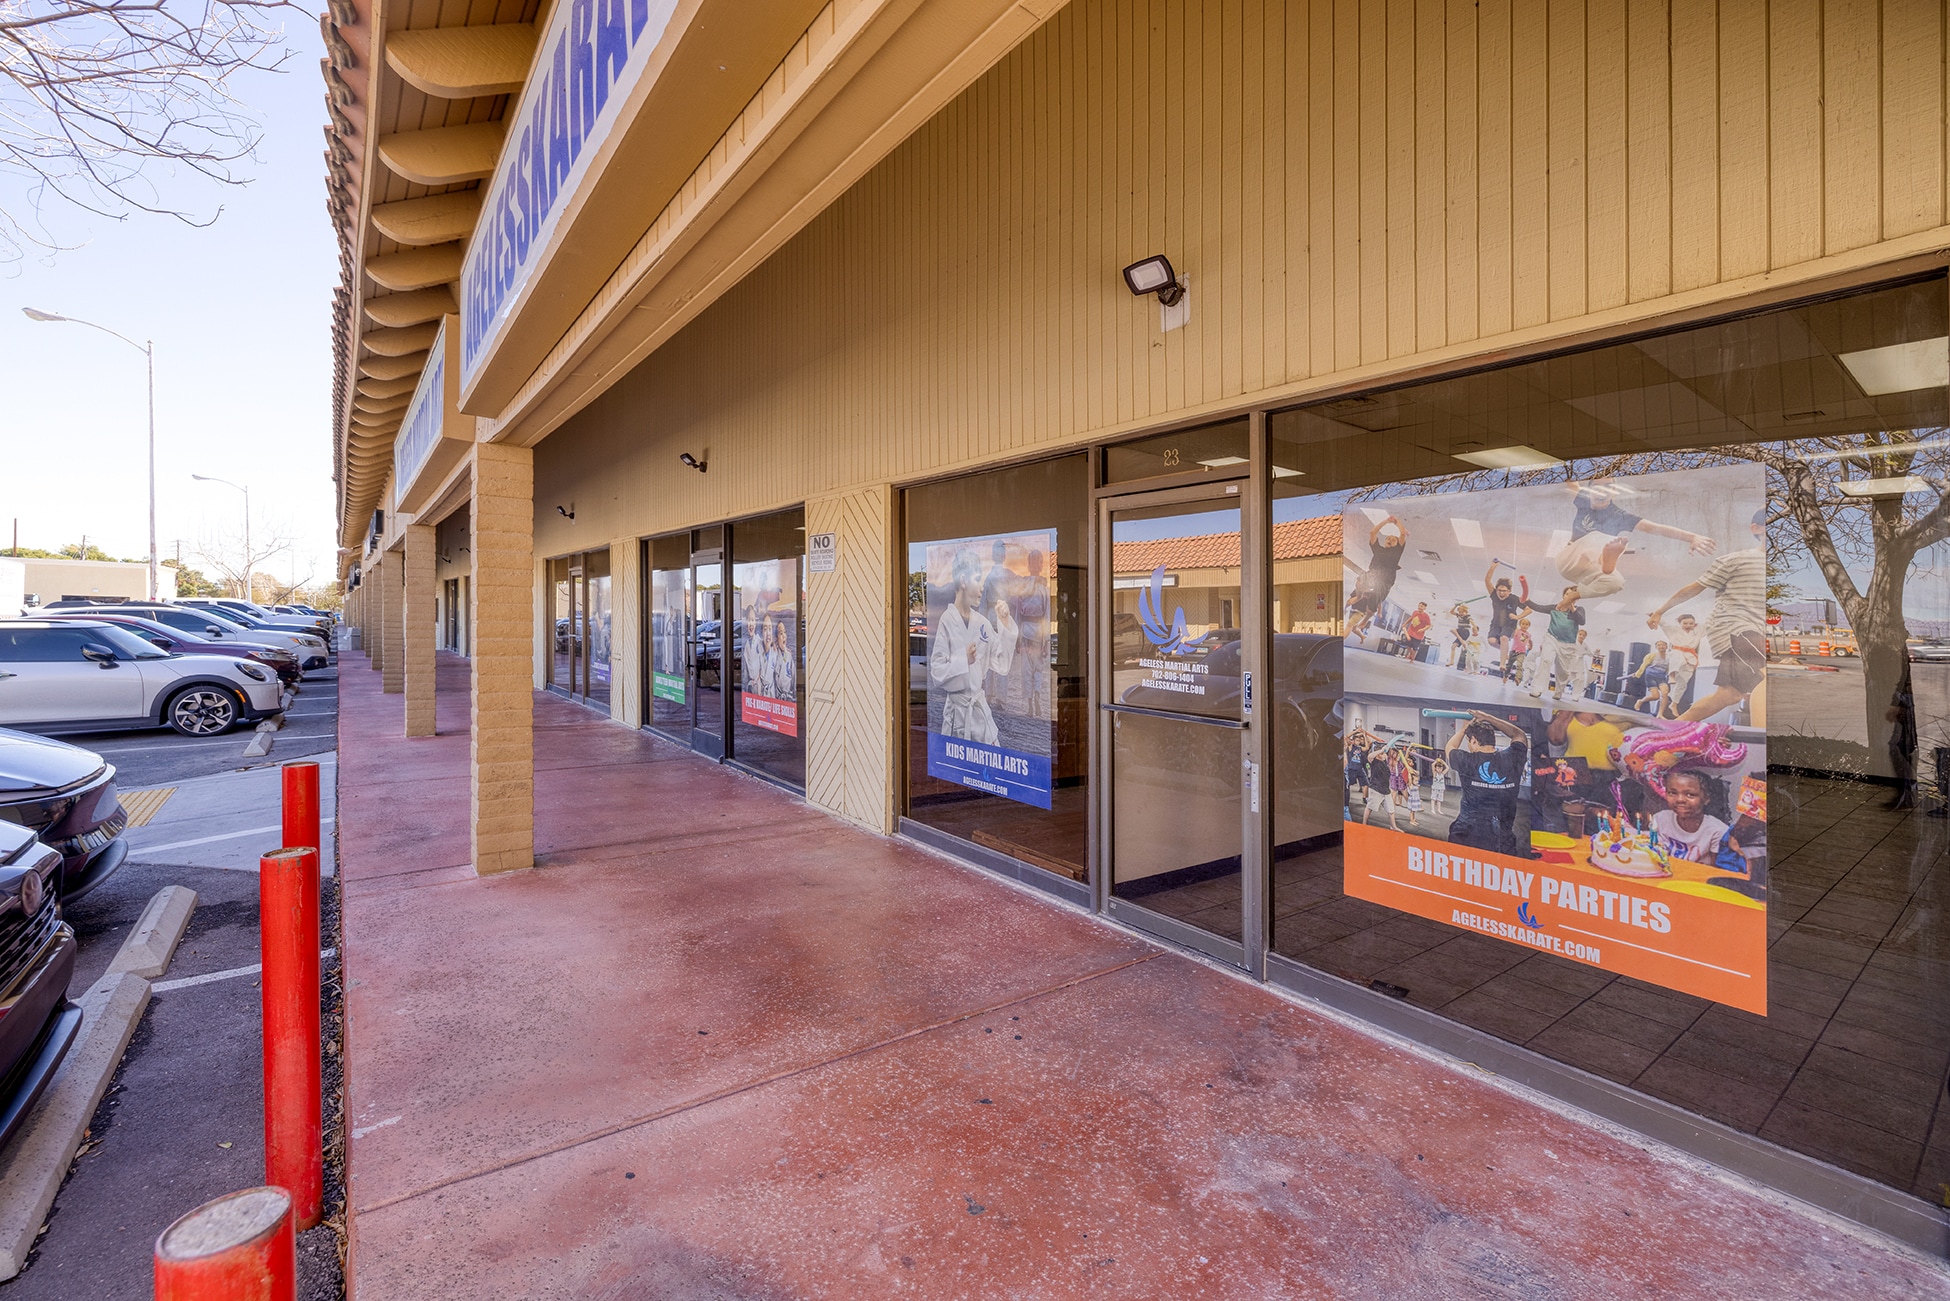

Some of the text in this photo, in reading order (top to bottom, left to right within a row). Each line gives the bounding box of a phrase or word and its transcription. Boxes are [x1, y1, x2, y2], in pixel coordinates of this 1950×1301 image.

[1163, 448, 1180, 467] 23
[813, 536, 830, 549] NO
[1139, 658, 1209, 674] AGELESS MARTIAL ARTS
[1141, 678, 1205, 695] AGELESSKARATE.COM
[945, 742, 1029, 776] KIDS MARTIAL ARTS
[963, 776, 1008, 796] AGELESSKARATE.COM
[1408, 846, 1671, 934] BIRTHDAY PARTIES
[1452, 909, 1601, 964] AGELESSKARATE.COM
